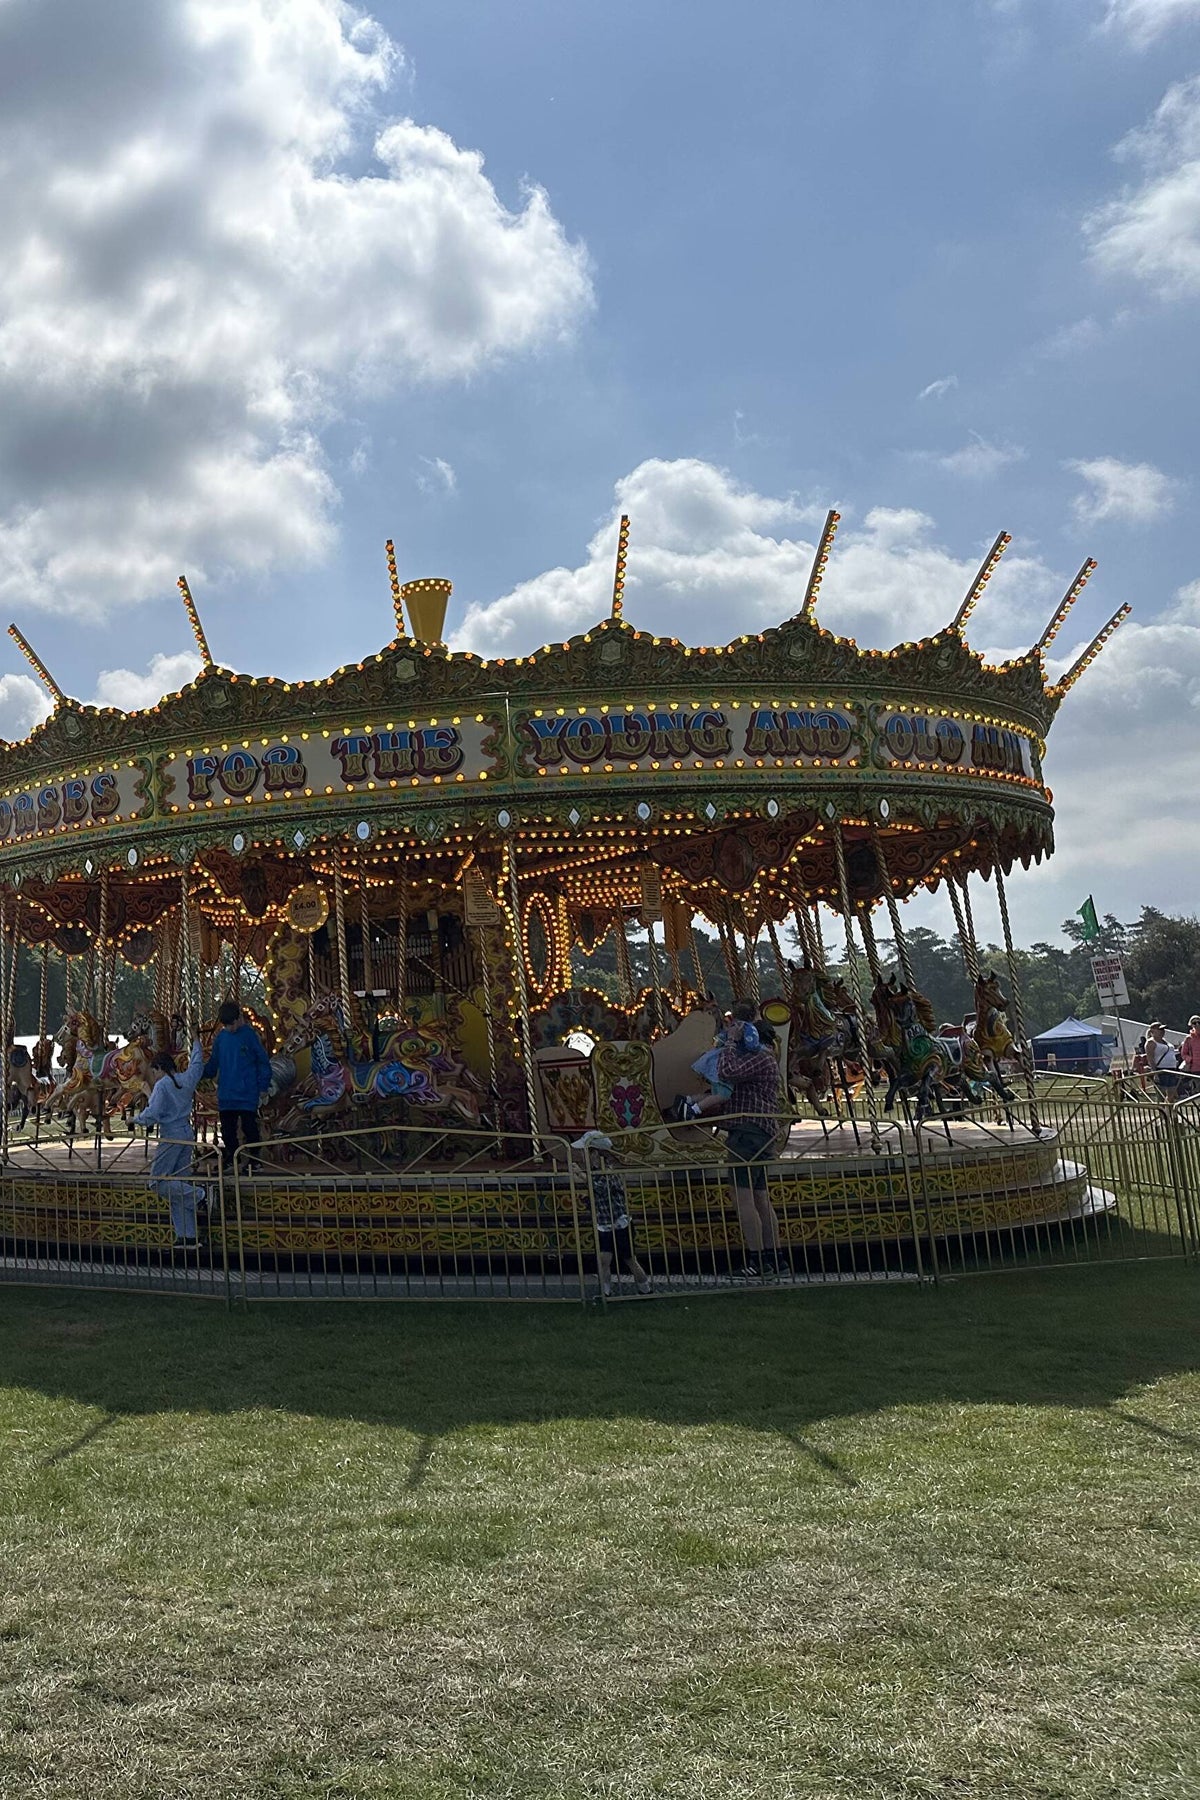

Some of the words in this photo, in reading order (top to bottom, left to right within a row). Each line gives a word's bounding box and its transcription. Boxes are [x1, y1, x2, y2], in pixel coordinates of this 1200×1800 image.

[187, 746, 307, 801] FOR
[331, 728, 463, 783] THE
[527, 711, 732, 765] YOUNG
[744, 710, 851, 757] AND
[885, 714, 965, 765] OLD
